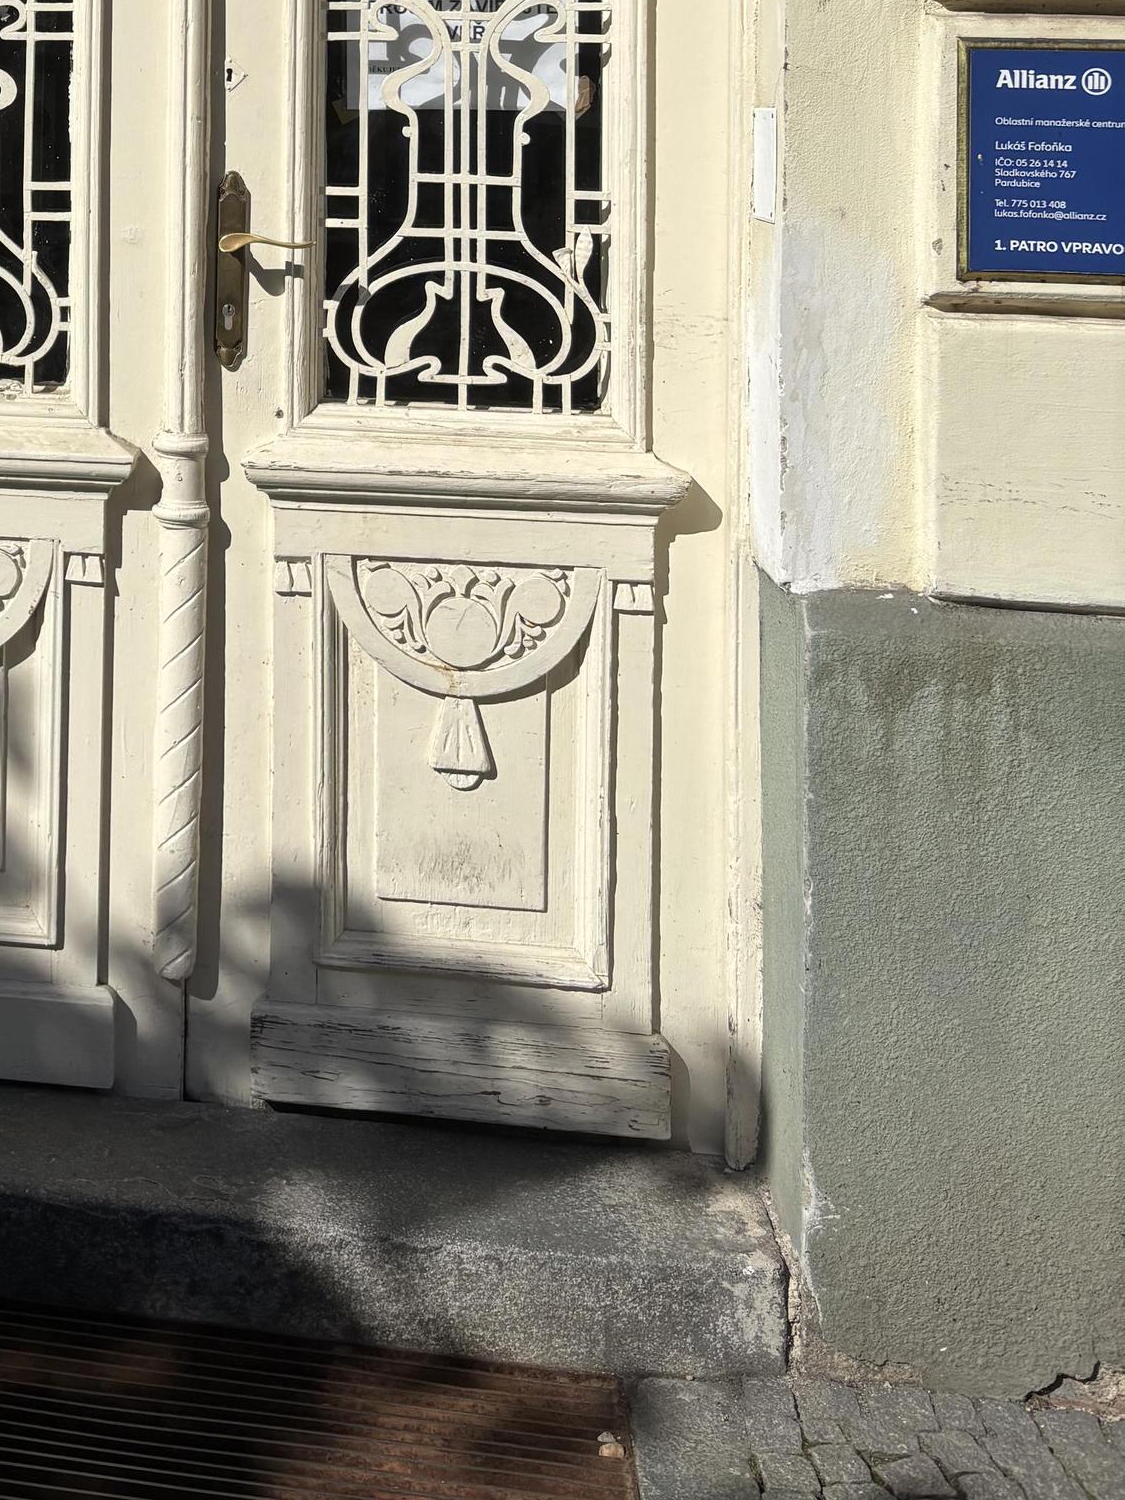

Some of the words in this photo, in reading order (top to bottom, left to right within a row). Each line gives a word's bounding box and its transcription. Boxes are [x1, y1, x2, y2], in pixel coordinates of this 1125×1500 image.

[996, 70, 1076, 89] Allianz
[995, 117, 1034, 126] Oblastní
[1035, 119, 1090, 127] manažerské
[995, 140, 1025, 150] Lukáš
[1028, 141, 1072, 152] Fofoňka
[995, 157, 1015, 166] IČO:
[1016, 159, 1027, 167] 05
[1029, 159, 1041, 167] 26
[995, 169, 1057, 178] Sladkovského
[1059, 170, 1076, 178] 767
[995, 179, 1040, 188] Pardubice
[995, 199, 1009, 207] Tel.
[1011, 200, 1028, 208] 775
[1030, 200, 1047, 208] 013
[1049, 201, 1066, 209] 408
[995, 209, 1107, 220] lukas.fofonka@allianz.cz
[995, 240, 1006, 250] 1.
[1010, 240, 1058, 252] PATRO
[1061, 242, 1124, 255] VPRAVO
